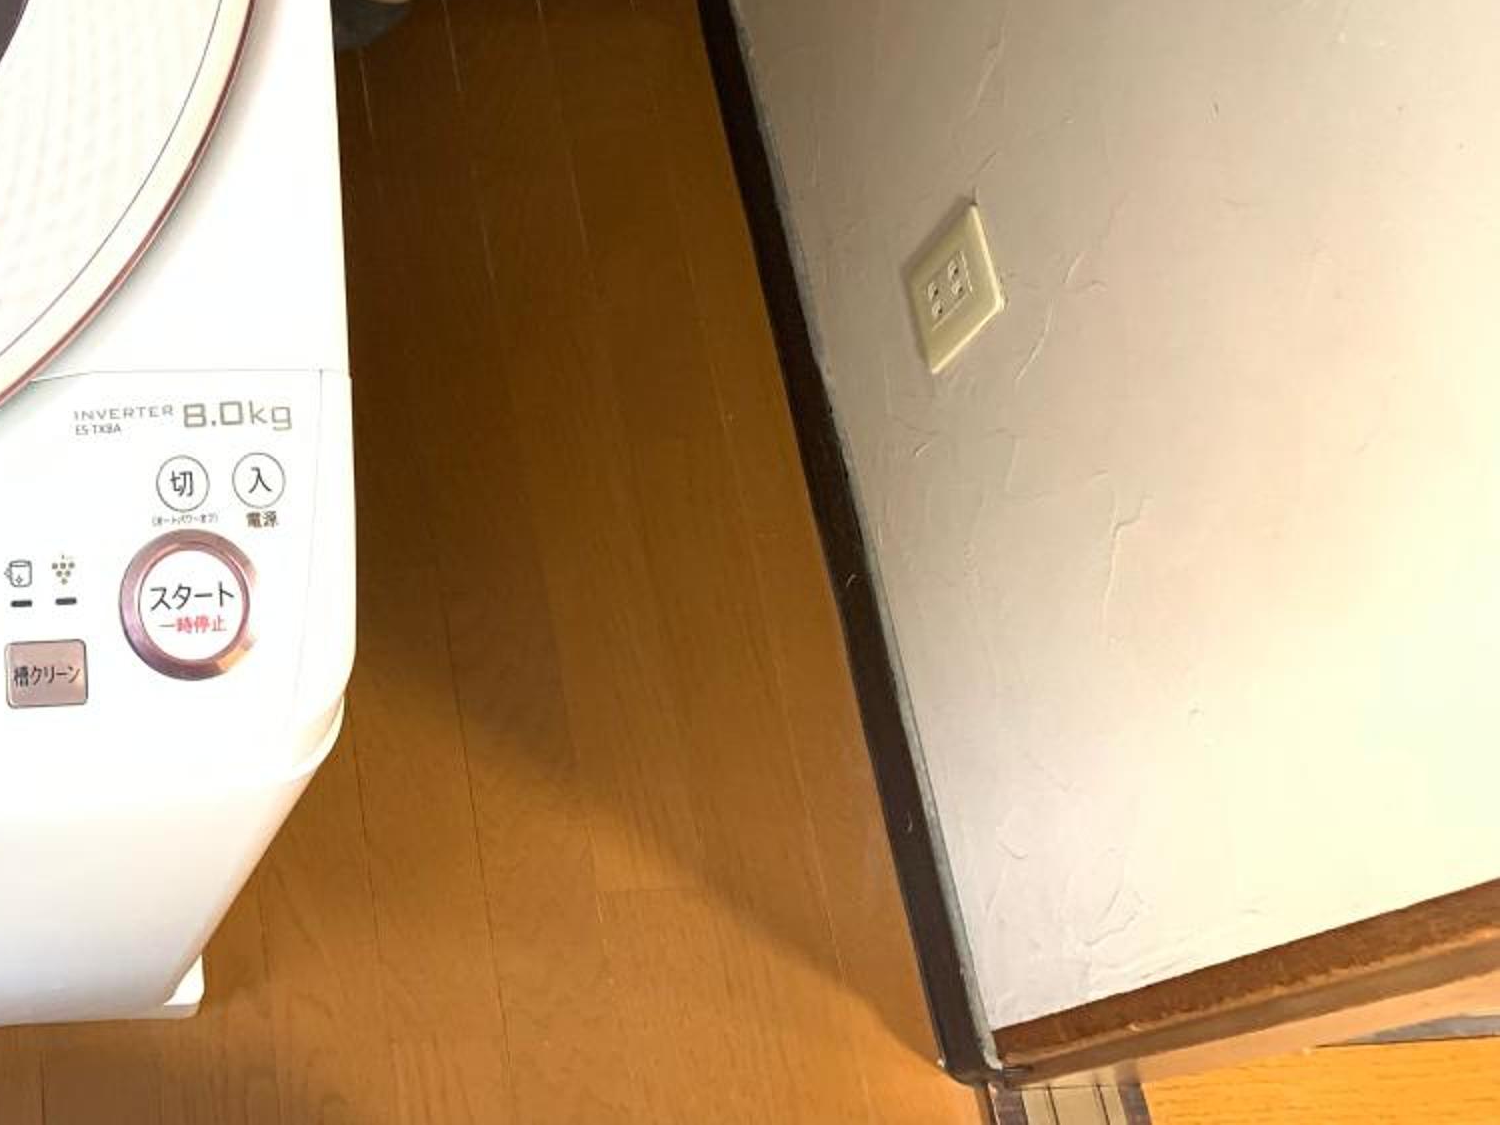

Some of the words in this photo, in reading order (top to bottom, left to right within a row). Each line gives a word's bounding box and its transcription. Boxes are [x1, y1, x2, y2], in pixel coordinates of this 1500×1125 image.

[74, 405, 174, 422] INVERTER
[183, 401, 293, 431] 8.0kg
[169, 470, 195, 498] 切
[247, 466, 273, 494] 入
[246, 511, 280, 528] 電源
[150, 581, 235, 613] スタート
[159, 615, 228, 634] 一時停止
[13, 666, 82, 687] 槽クリーン
